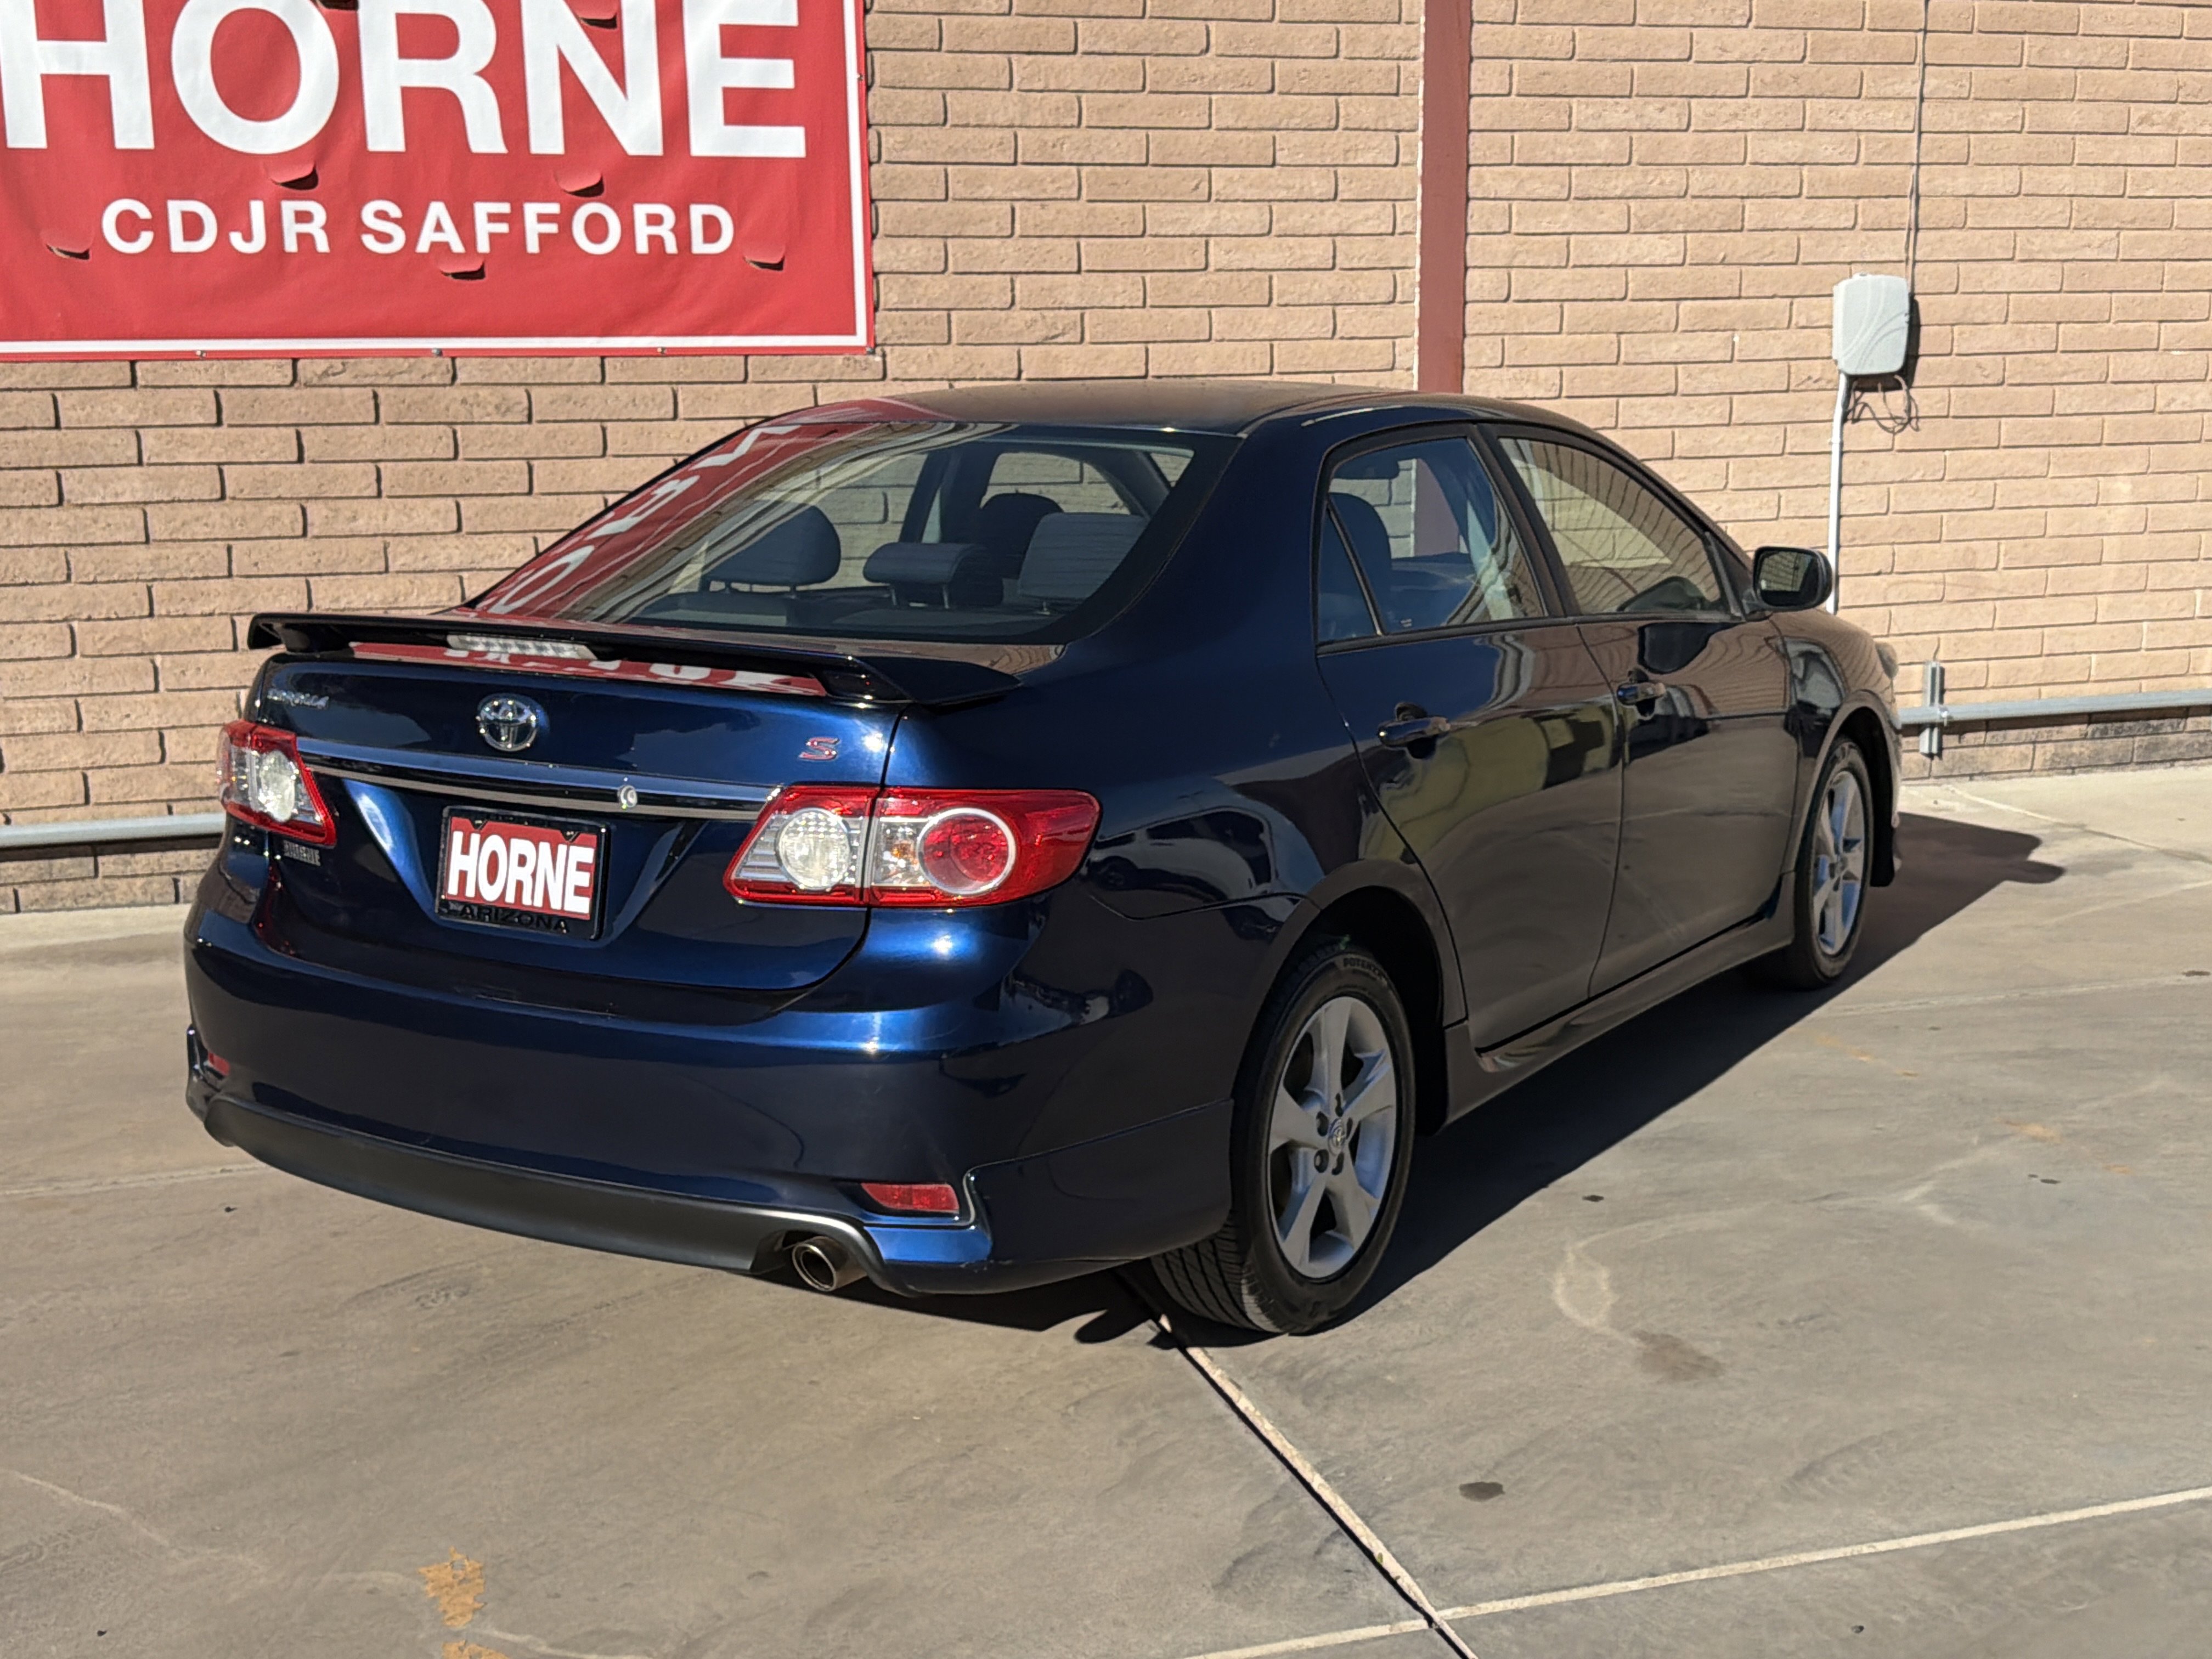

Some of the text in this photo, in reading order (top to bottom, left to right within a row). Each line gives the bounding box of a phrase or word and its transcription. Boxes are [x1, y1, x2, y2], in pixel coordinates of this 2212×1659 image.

[0, 0, 806, 157] HORNE
[101, 198, 735, 255] CDJR SAFFORD
[798, 737, 840, 761] S
[447, 830, 595, 915] HORNE
[459, 905, 569, 934] ARIZONA
